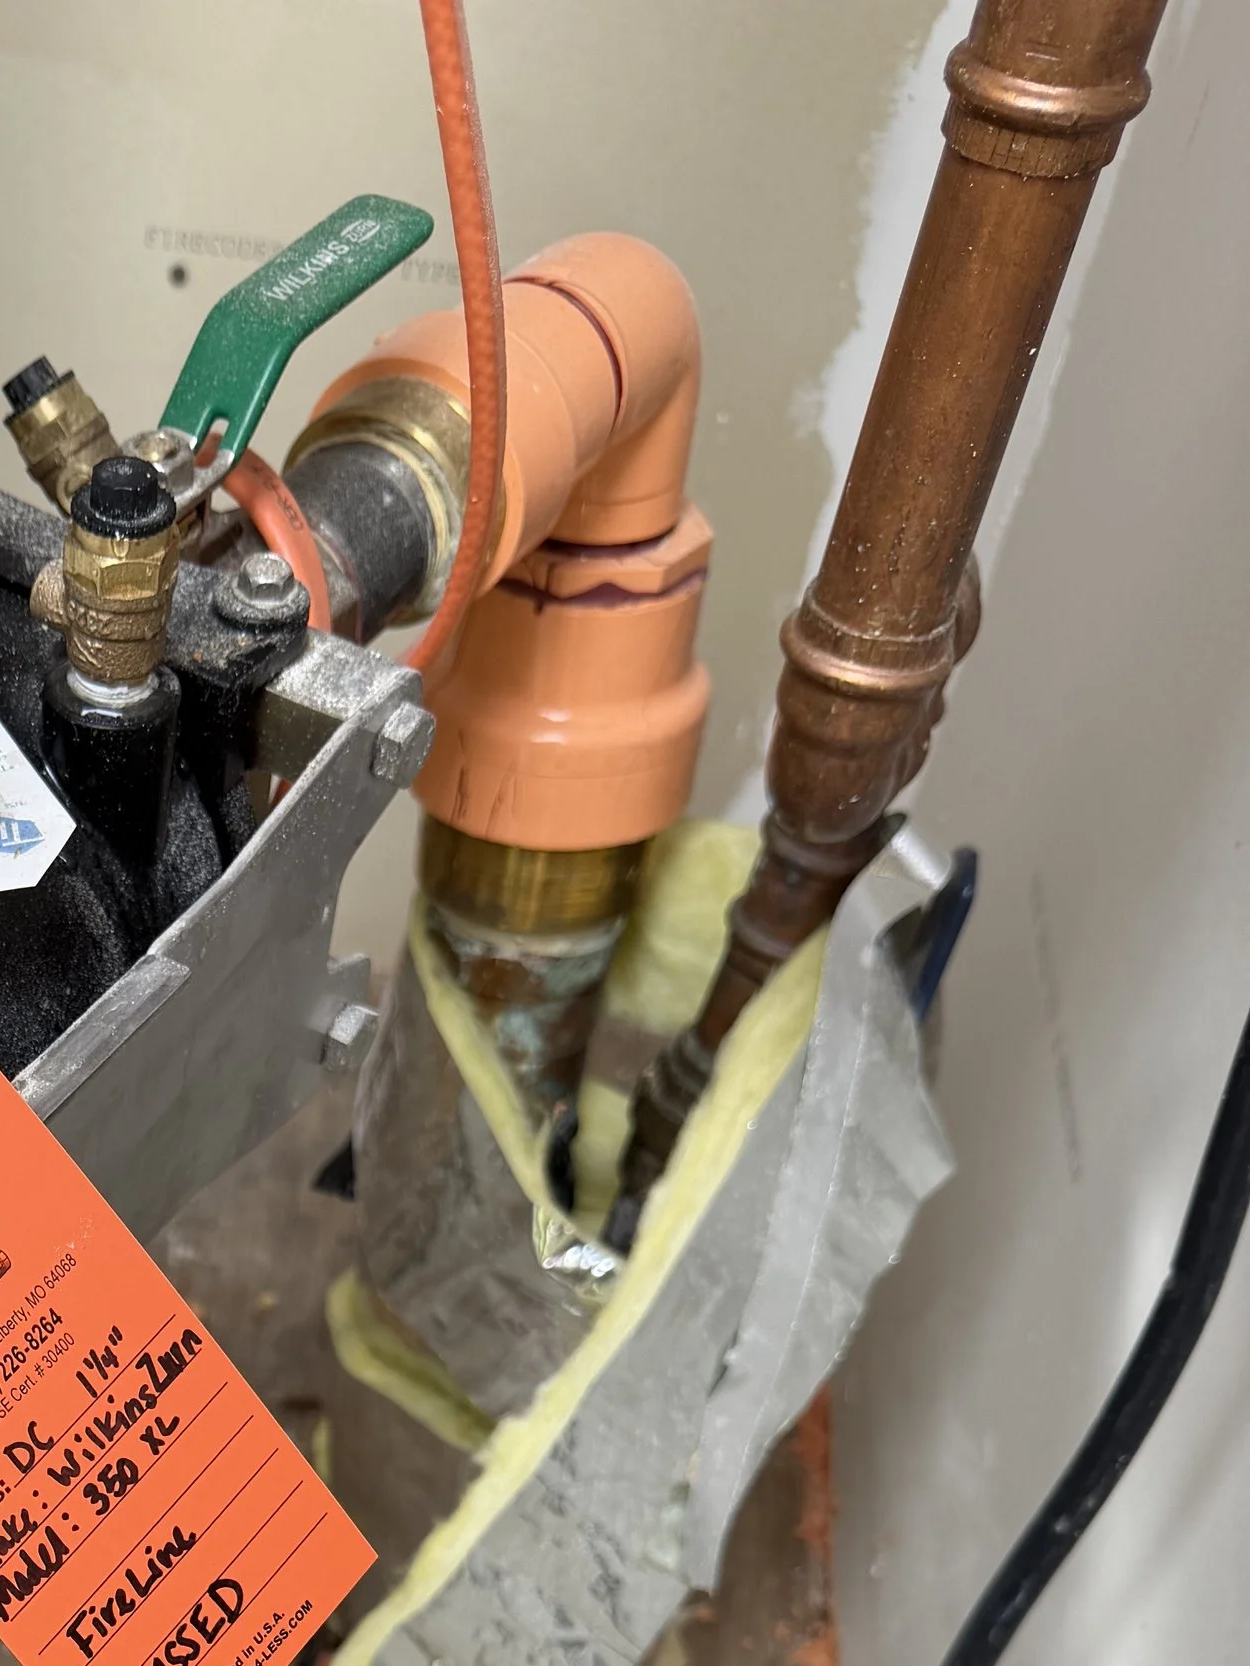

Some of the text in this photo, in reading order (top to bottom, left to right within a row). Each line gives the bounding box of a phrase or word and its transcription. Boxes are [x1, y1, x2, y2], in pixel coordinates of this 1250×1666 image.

[265, 219, 379, 302] WILKINS ZURN
[25, 1285, 46, 1308] MO
[44, 1254, 76, 1288] 64068
[11, 1375, 35, 1401] Cert.
[34, 1363, 43, 1377] #
[42, 1333, 74, 1368] 30400
[4, 1422, 53, 1473] DC
[84, 1459, 139, 1515] 350
[140, 1417, 179, 1455] XL
[242, 1645, 255, 1659] in
[253, 1613, 294, 1647] U.S.A.
